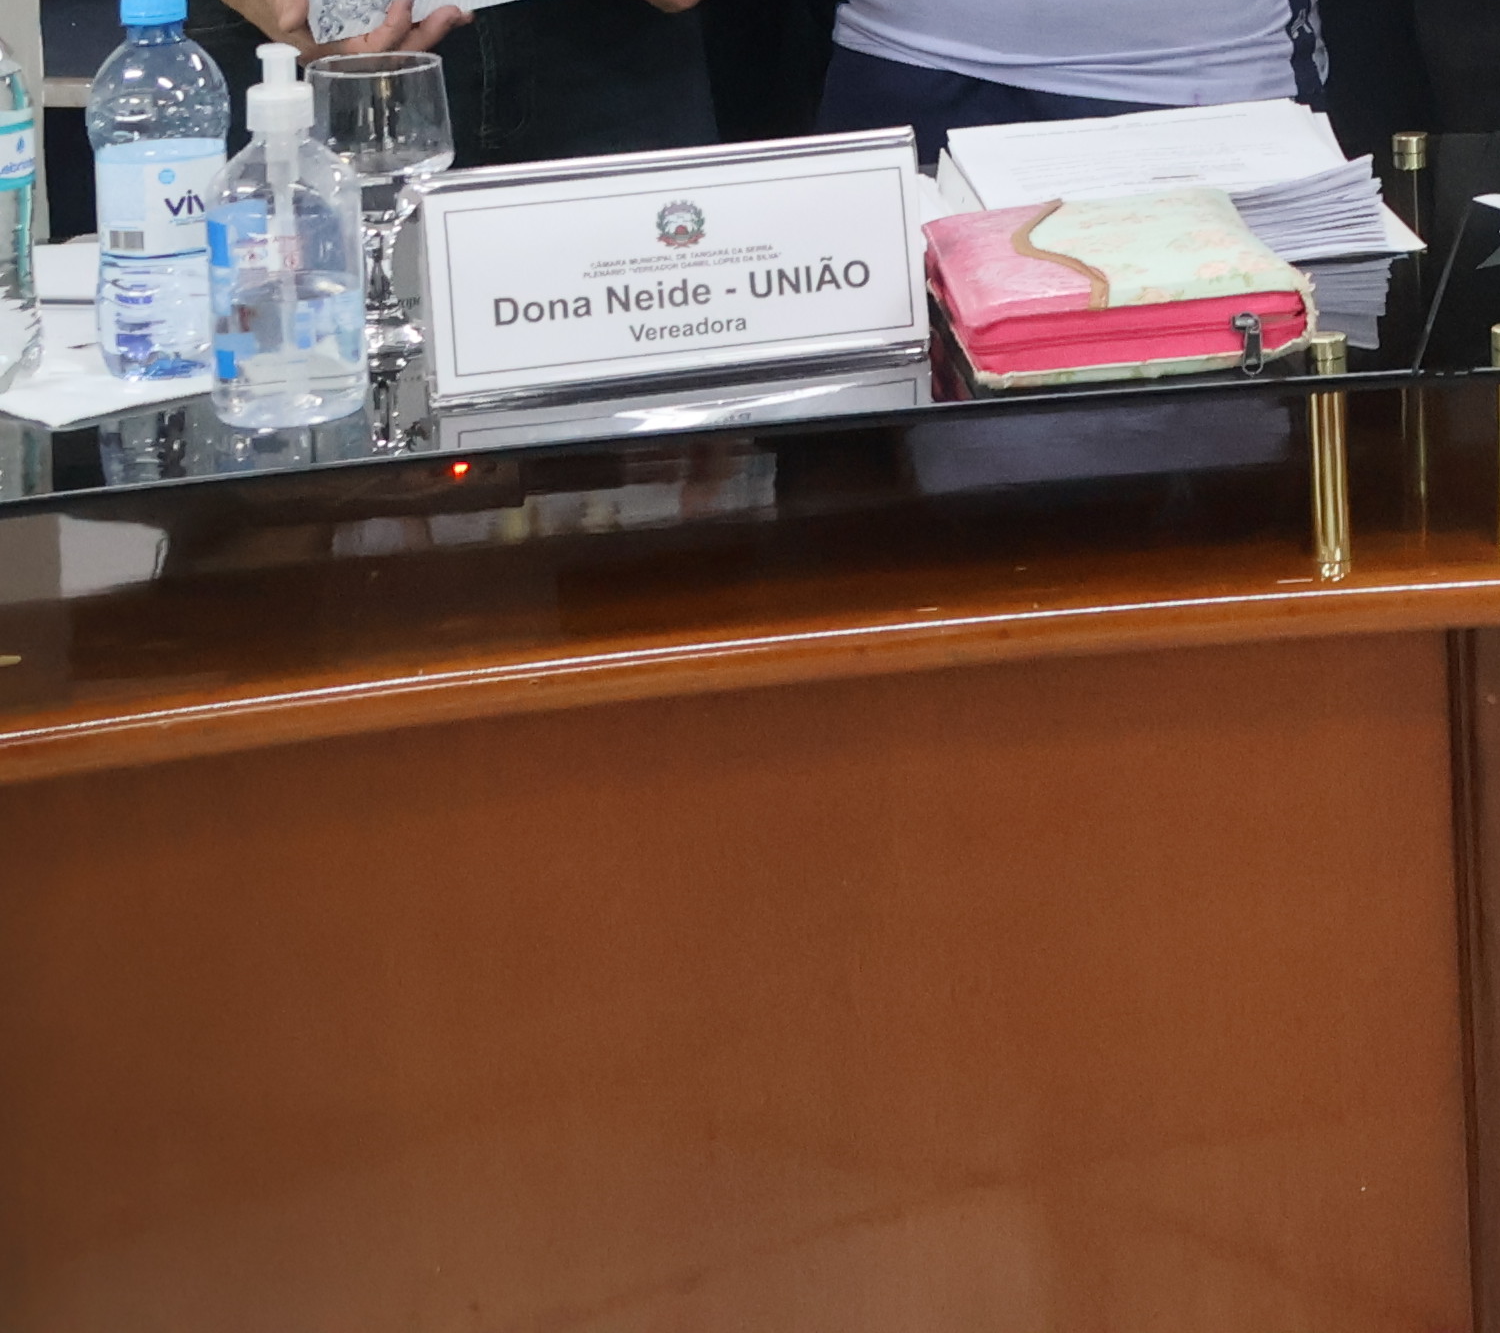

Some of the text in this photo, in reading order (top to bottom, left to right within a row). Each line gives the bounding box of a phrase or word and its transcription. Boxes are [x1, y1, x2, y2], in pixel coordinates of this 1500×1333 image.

[494, 296, 592, 327] Dona
[605, 277, 712, 315] Neide
[749, 256, 872, 299] UNIÃO
[629, 317, 748, 343] Vereadora
